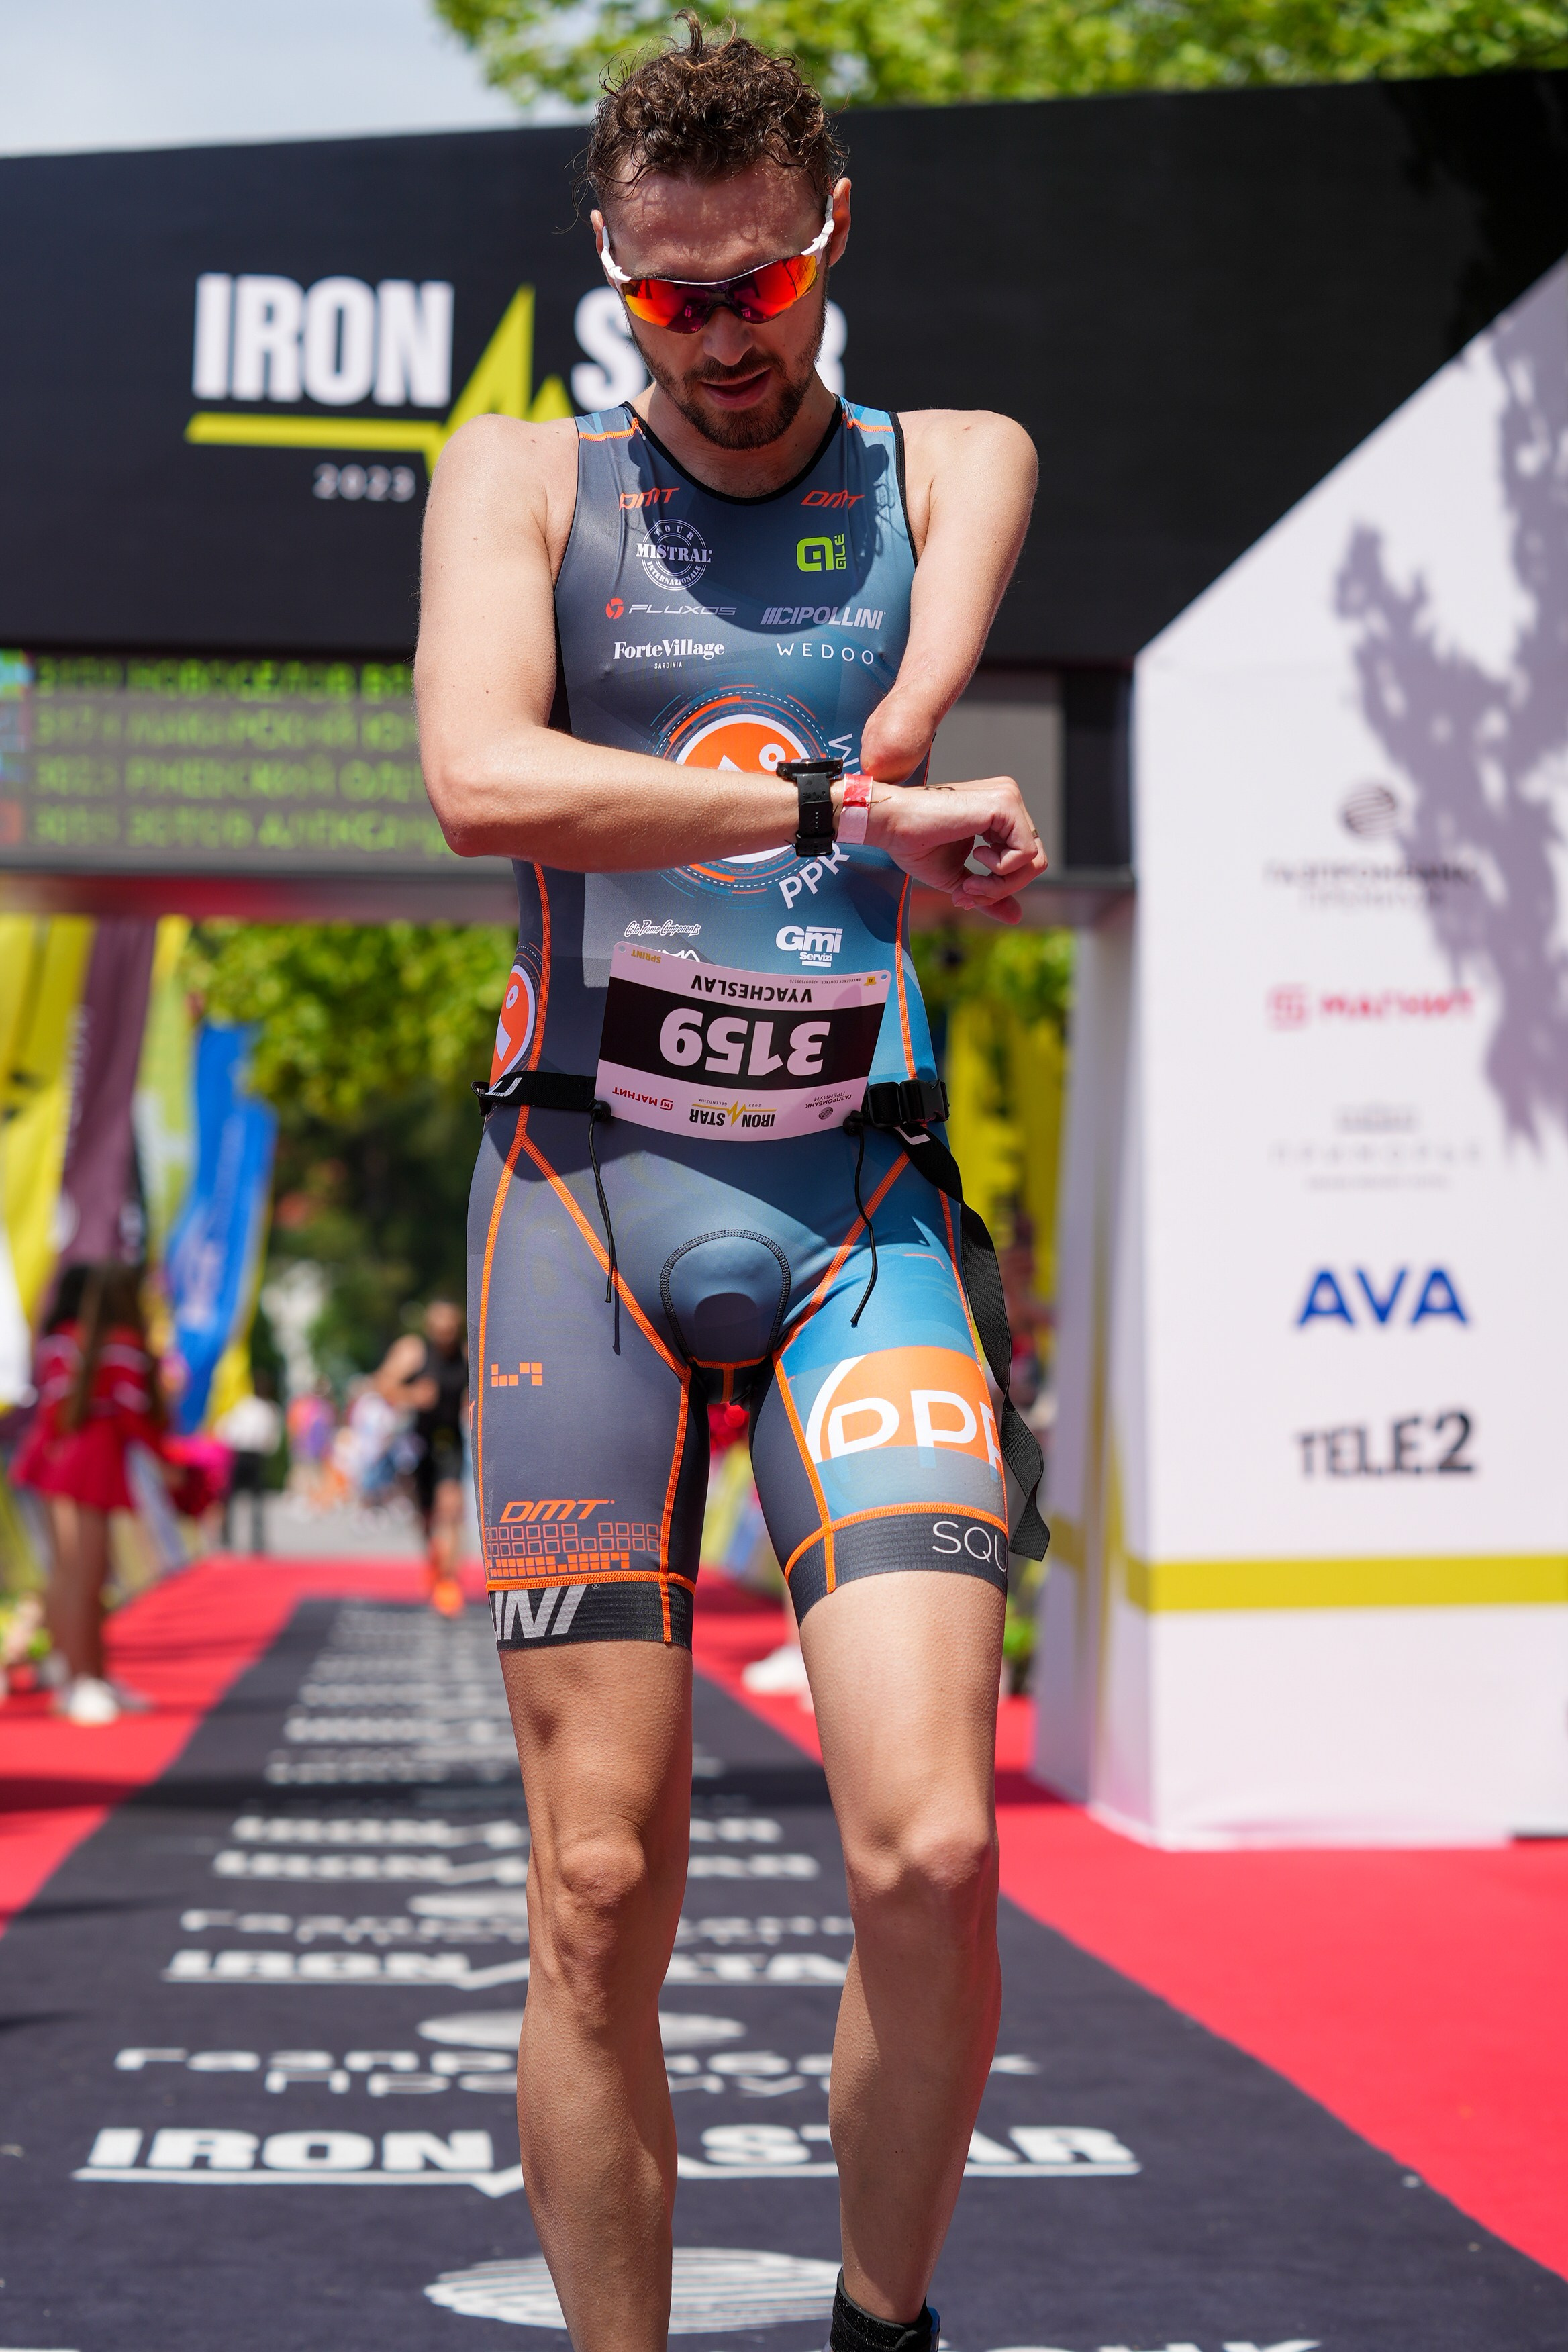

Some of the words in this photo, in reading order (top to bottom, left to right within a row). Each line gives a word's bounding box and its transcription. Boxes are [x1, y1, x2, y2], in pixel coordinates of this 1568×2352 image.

[193, 272, 454, 407] IRON
[313, 463, 415, 501] 2023
[619, 487, 680, 511] DMT
[801, 489, 865, 509] DMT
[654, 524, 694, 541] TOUR
[636, 543, 712, 563] MISTRAL
[646, 561, 701, 586] INTERNAZIONALE
[629, 604, 737, 616] FLUXOS
[765, 606, 884, 630] CIPOLLINI
[776, 642, 874, 665] WEDOO
[654, 661, 683, 669] SARDINIA
[639, 920, 660, 936] Promo
[660, 919, 701, 937] Components
[775, 926, 844, 953] Gmi
[631, 949, 662, 964] SPRINT
[799, 952, 832, 962] Servizi
[691, 975, 812, 1003] VYACHESLAV
[660, 1008, 831, 1076] 3159
[612, 1087, 658, 1106] МАГНИТ
[698, 1098, 728, 1106] GELENDZHIK
[805, 1094, 852, 1108] ГАЗПРОМБАНК
[814, 1091, 845, 1102] ПРЕМИУМ
[689, 1109, 726, 1126] STAR
[741, 1114, 775, 1127] IRON
[1295, 1267, 1471, 1328] AVA
[1297, 1408, 1476, 1477] TELE2
[500, 1500, 610, 1524] DMT
[87, 2128, 494, 2171] IRON
